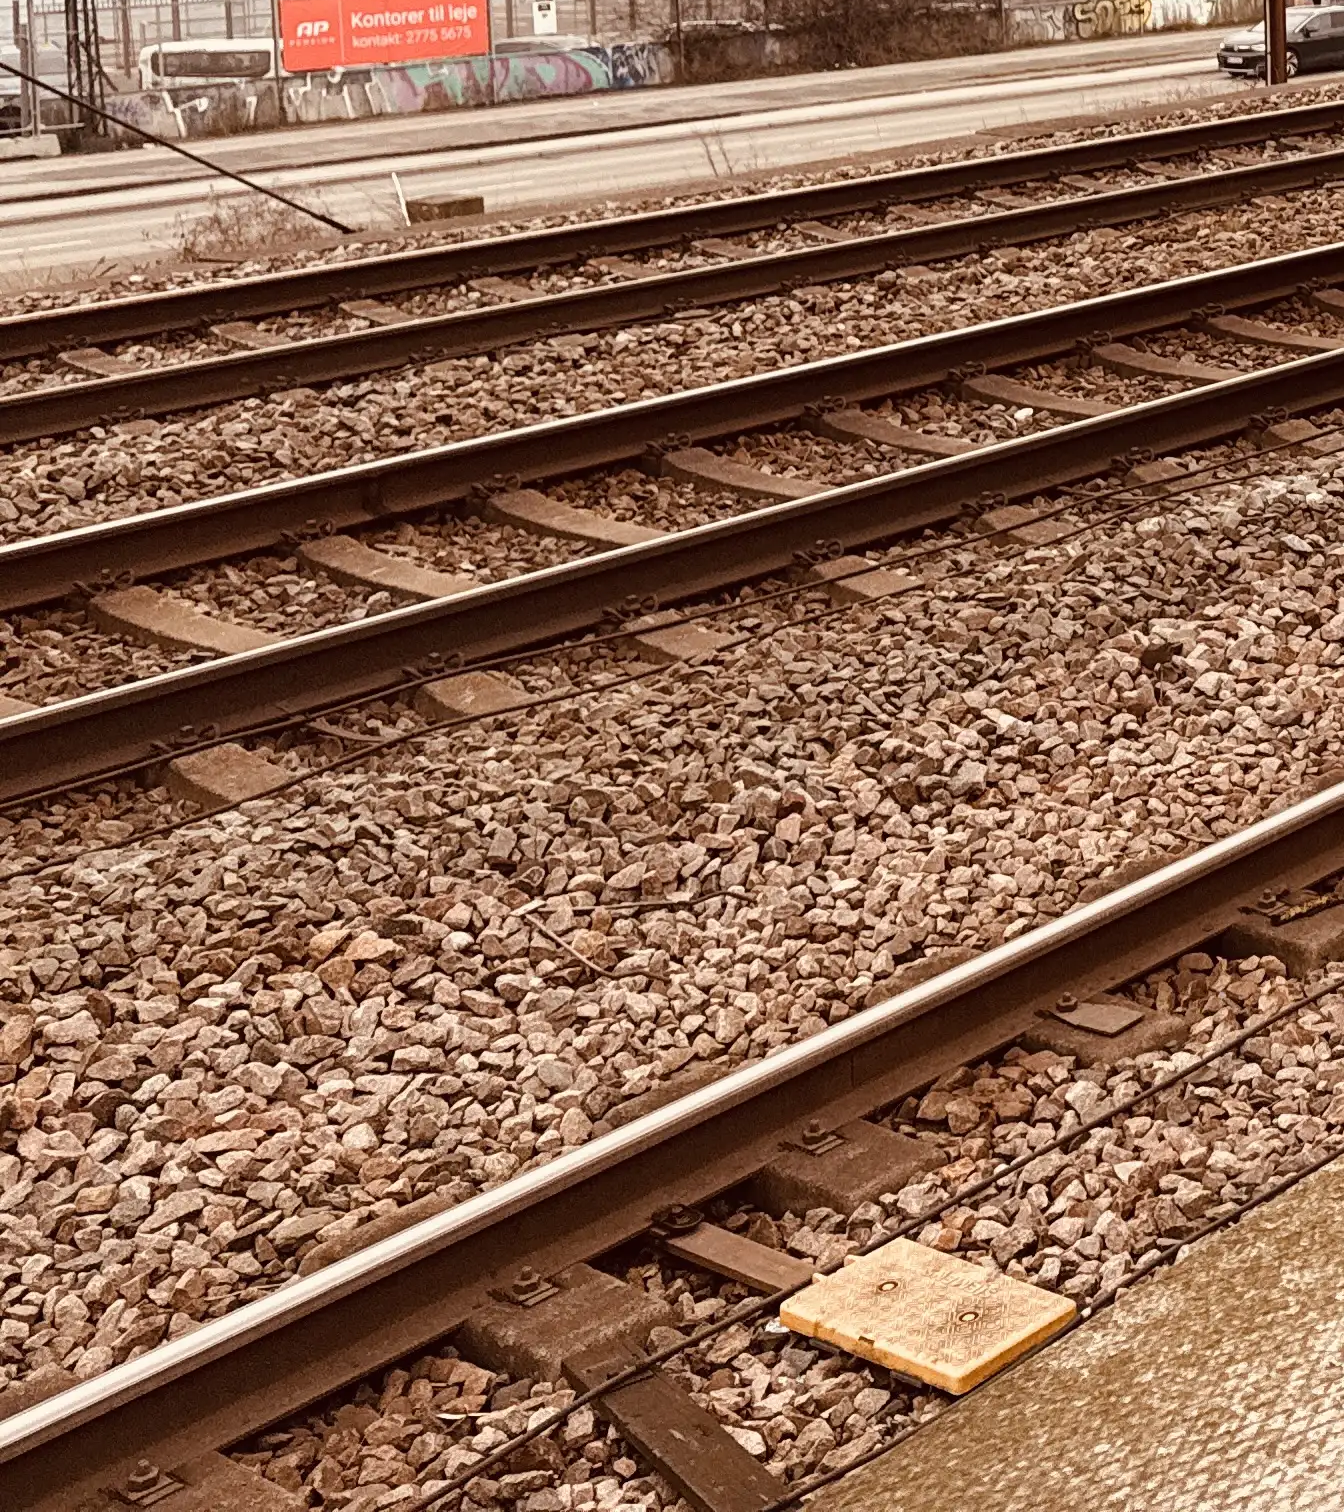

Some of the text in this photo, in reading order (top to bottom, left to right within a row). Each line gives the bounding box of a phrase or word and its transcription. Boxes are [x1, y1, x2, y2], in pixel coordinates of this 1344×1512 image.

[351, 3, 478, 28] Kontorer til leje
[296, 20, 330, 37] AP
[406, 28, 438, 44] 2775
[440, 25, 472, 40] 5675
